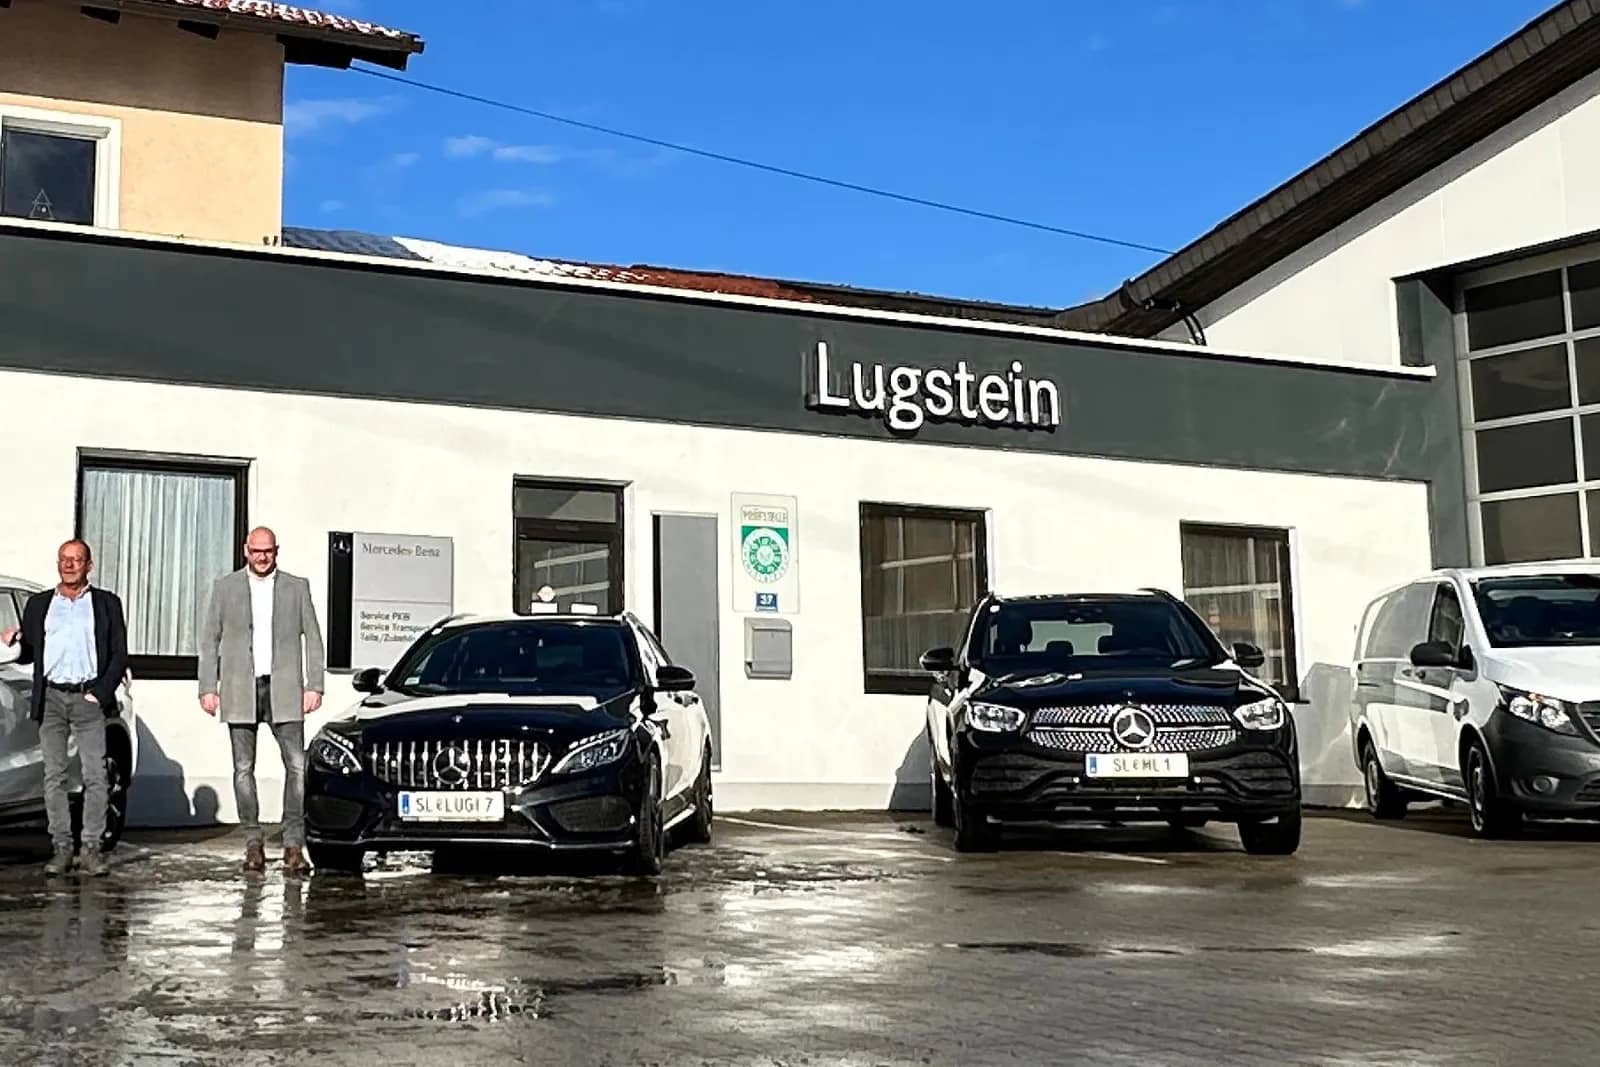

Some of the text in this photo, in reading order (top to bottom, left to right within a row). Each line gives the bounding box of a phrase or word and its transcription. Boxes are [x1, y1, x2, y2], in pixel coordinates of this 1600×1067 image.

[814, 340, 1061, 431] Lugstein
[360, 611, 390, 620] Service
[360, 621, 390, 631] Service
[416, 797, 432, 813] SL
[485, 797, 494, 812] 7
